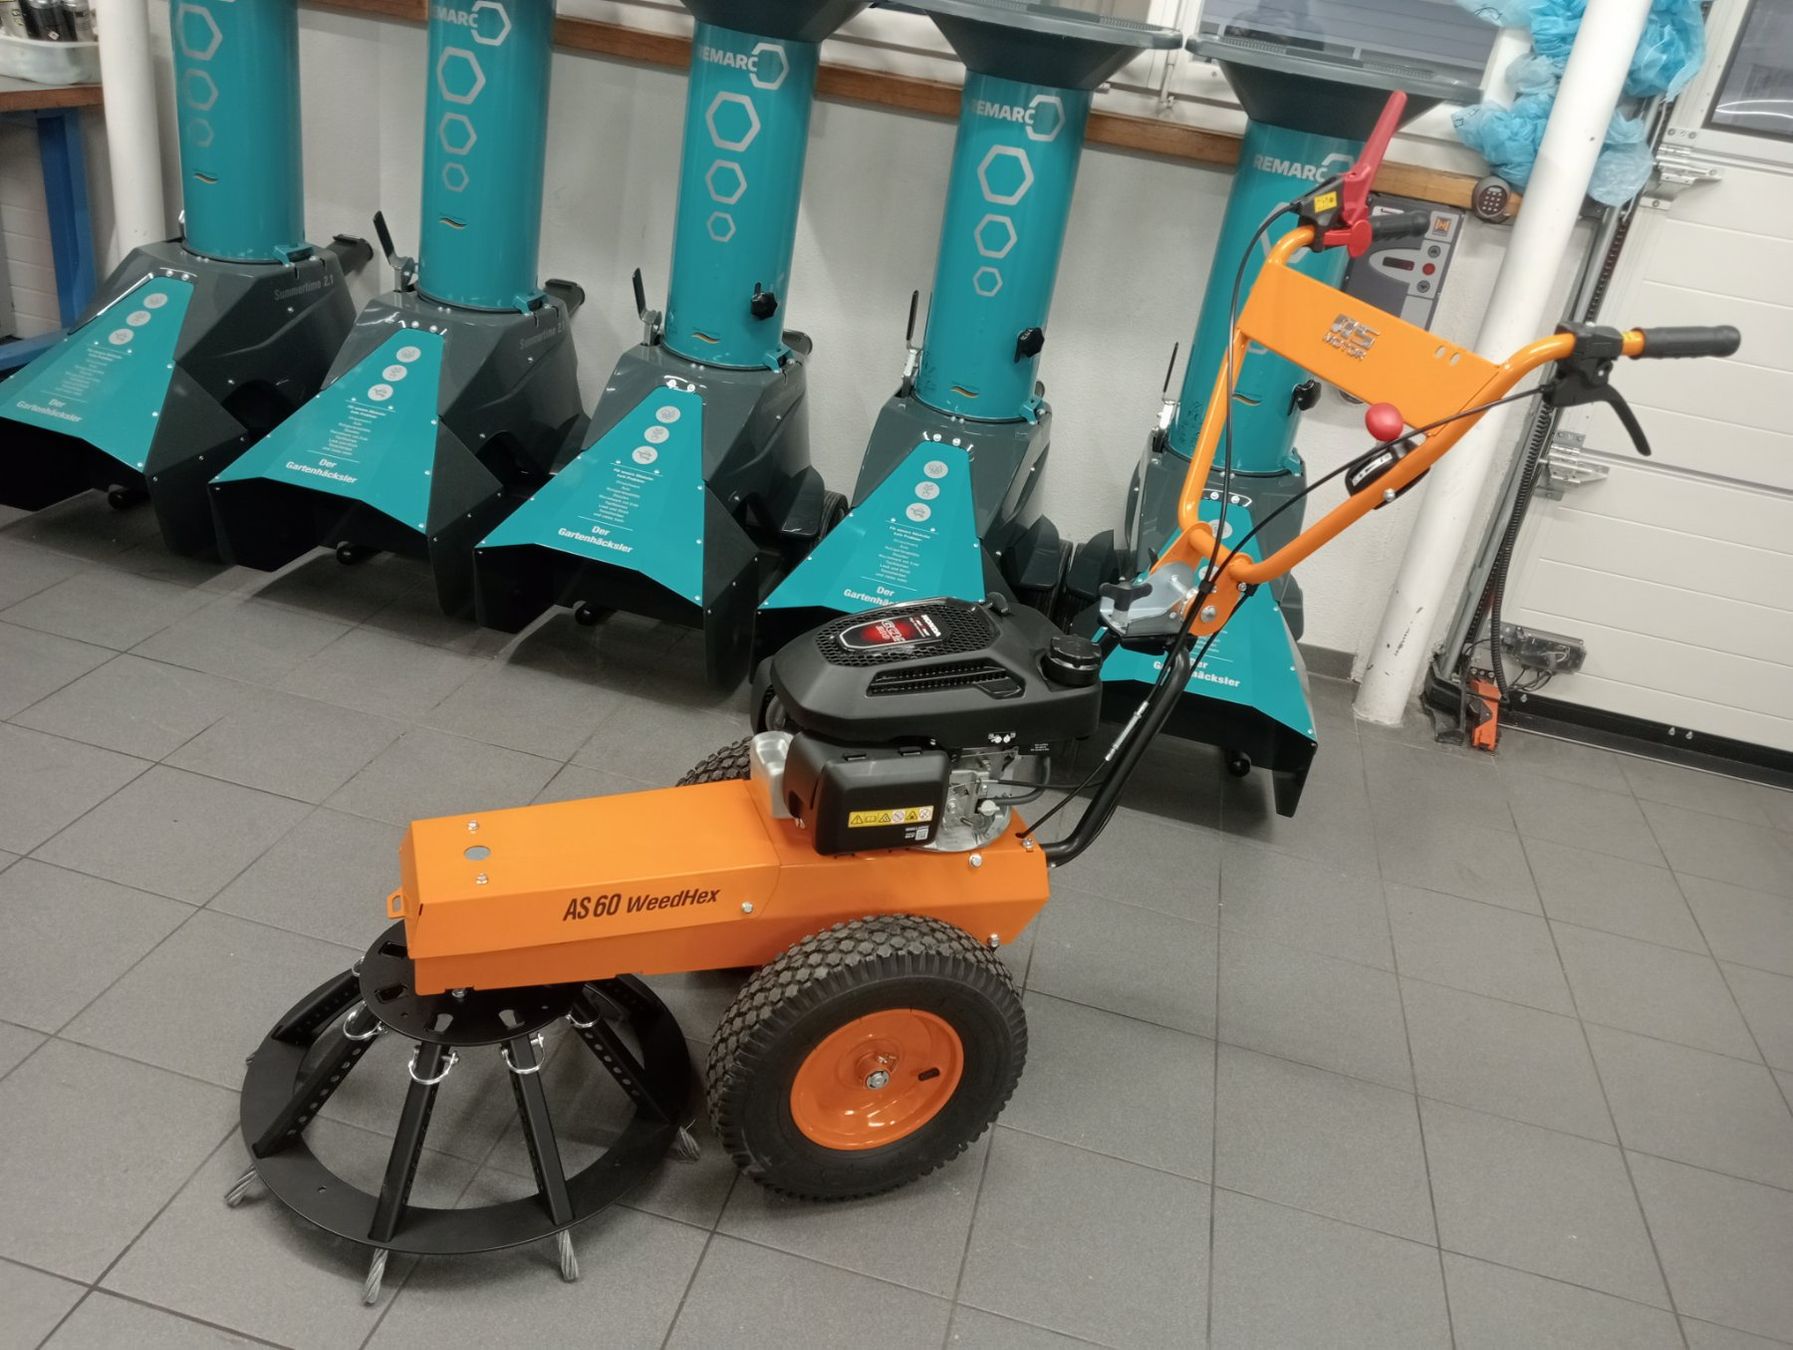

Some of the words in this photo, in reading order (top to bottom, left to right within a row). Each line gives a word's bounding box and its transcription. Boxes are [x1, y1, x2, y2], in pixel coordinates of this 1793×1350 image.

[1254, 154, 1328, 183] REMARC
[286, 461, 358, 484] Gartenhäcksler
[319, 458, 337, 468] Der
[558, 527, 634, 553] Gartenhäcksler
[591, 525, 611, 536] Der
[876, 586, 896, 597] Der
[563, 896, 591, 922] AS
[593, 893, 621, 918] 60
[626, 889, 720, 914] WeedHex
